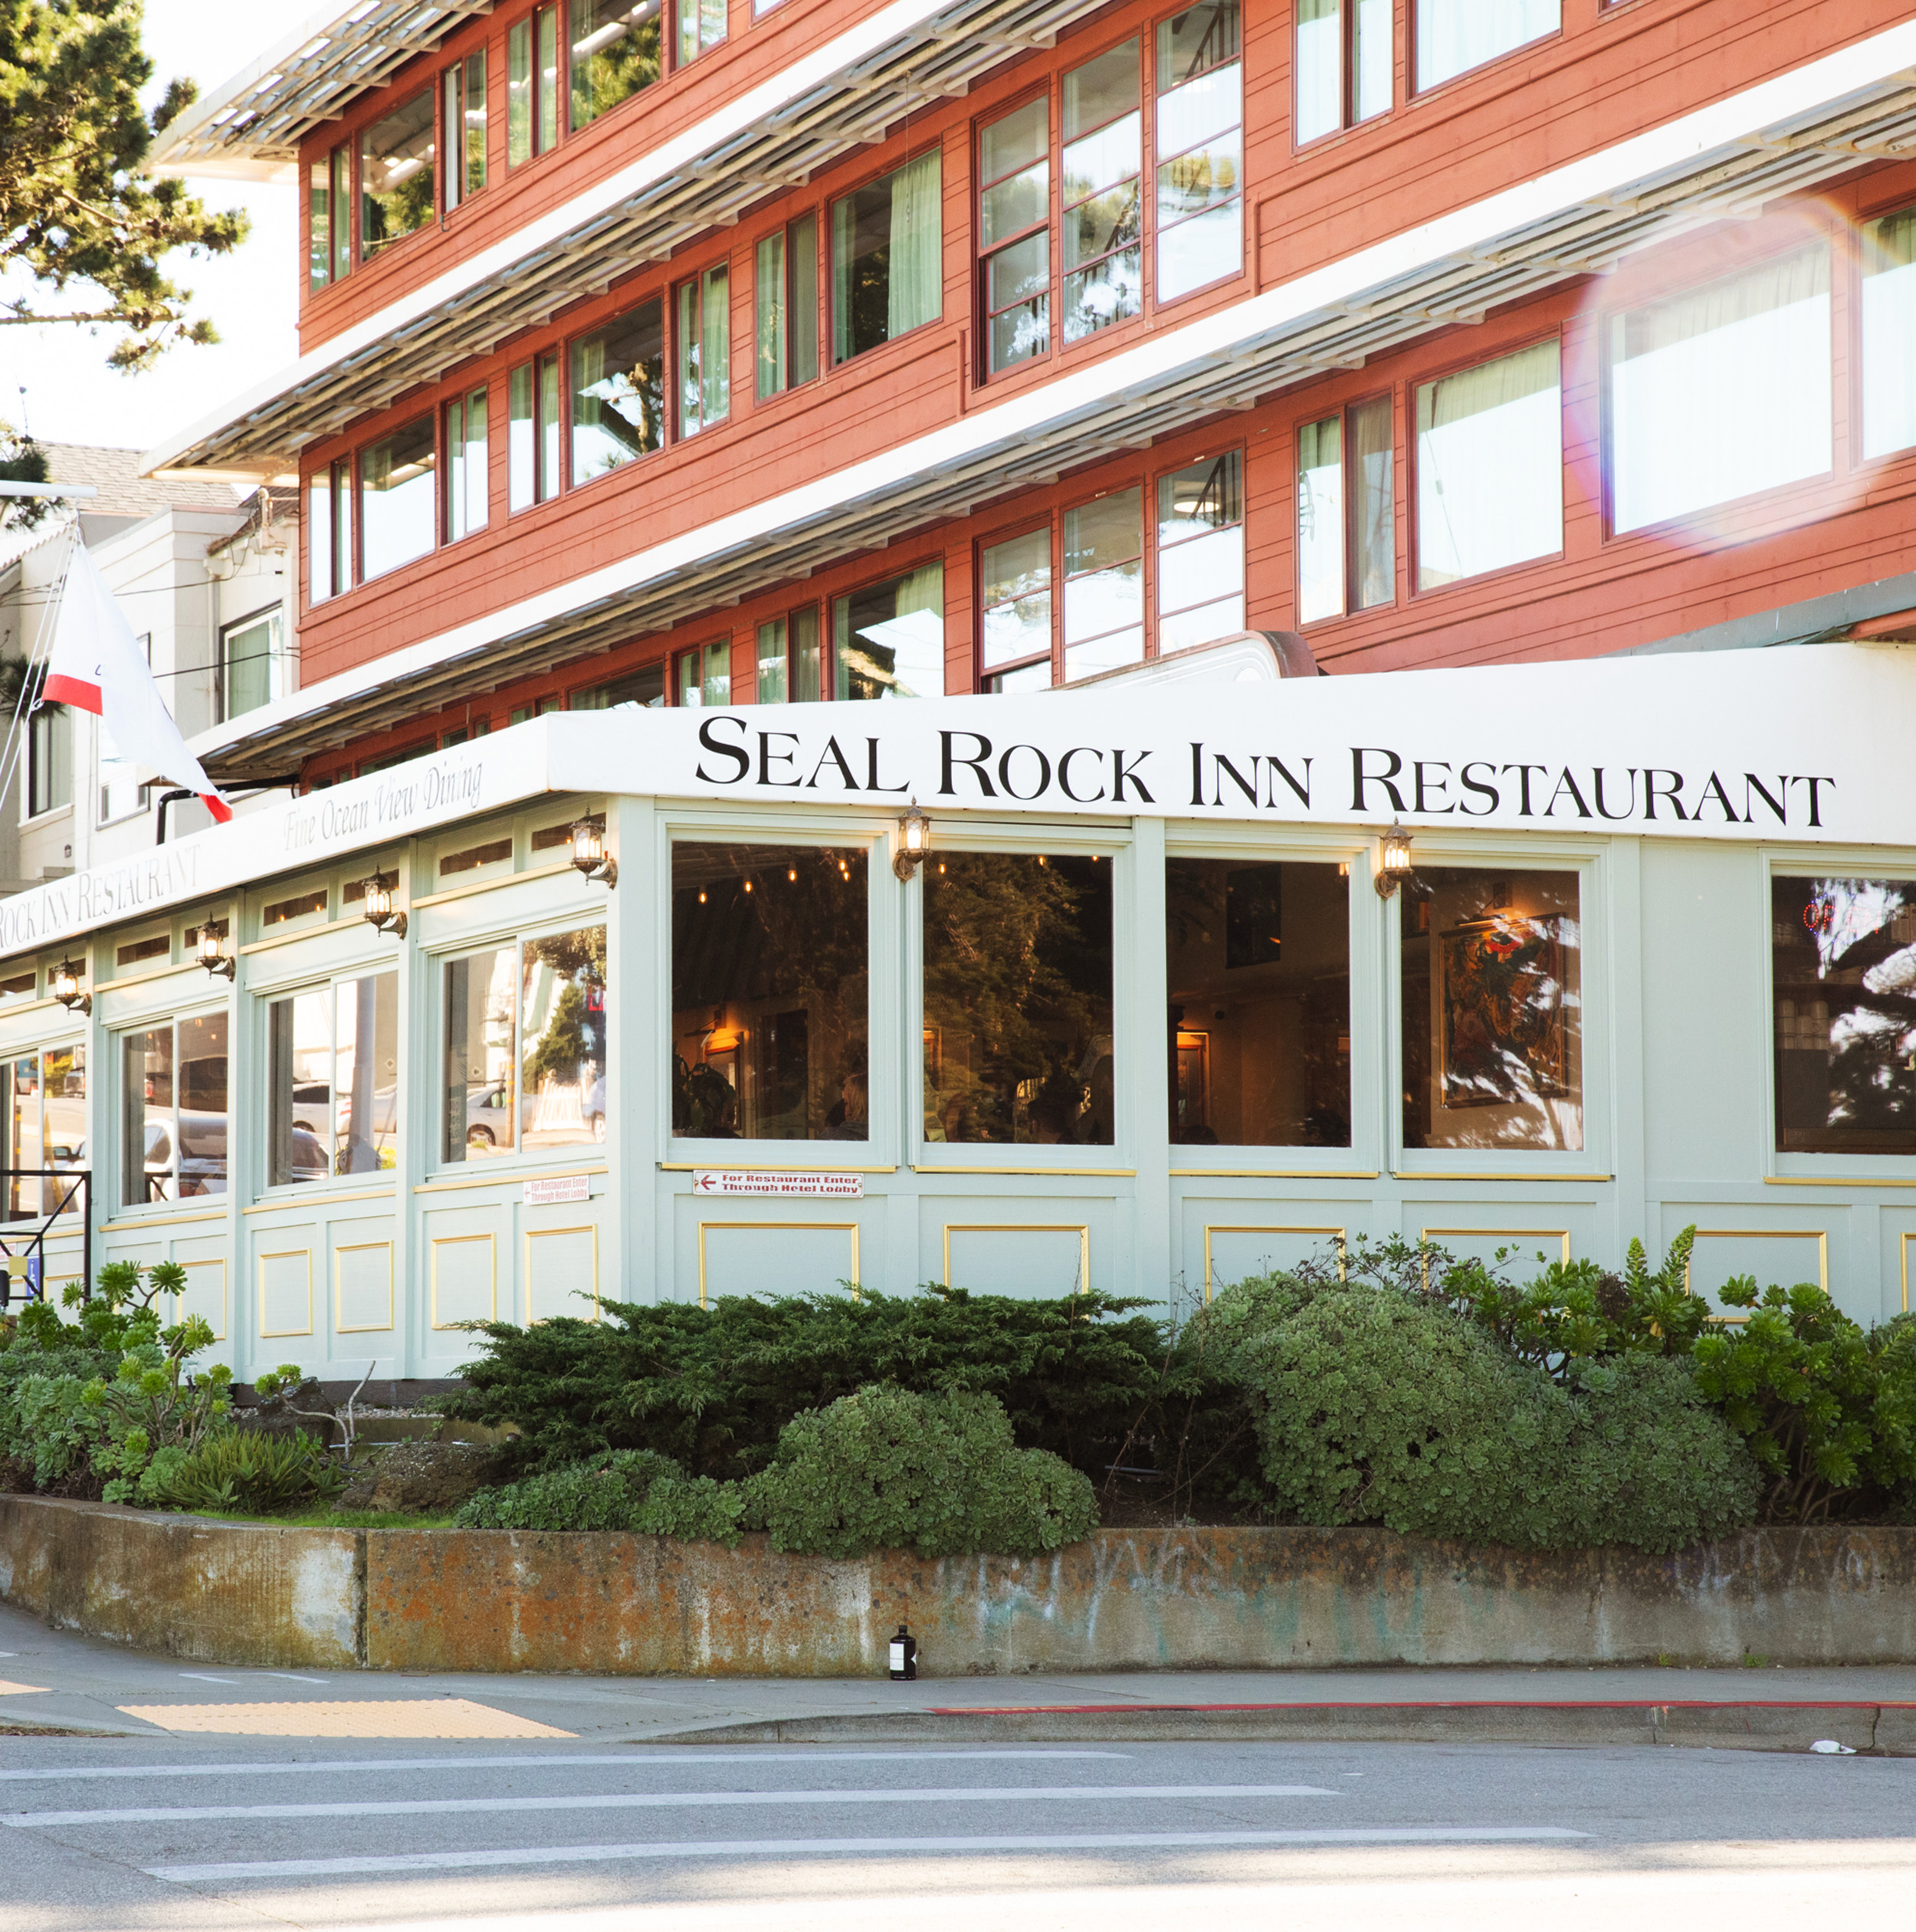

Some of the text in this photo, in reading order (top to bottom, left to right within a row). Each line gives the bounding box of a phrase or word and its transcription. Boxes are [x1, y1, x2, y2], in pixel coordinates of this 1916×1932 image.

[695, 716, 1837, 827] SEAL ROCK INN RESTAURANT
[284, 756, 483, 851] Fine Ocean View Dining
[531, 1177, 587, 1192] For Restaurant Enter
[746, 1175, 821, 1183] Restaurant
[531, 1189, 587, 1202] Through Hotel Lobby
[722, 1183, 778, 1192] Through
[819, 1185, 858, 1194] Lobby
